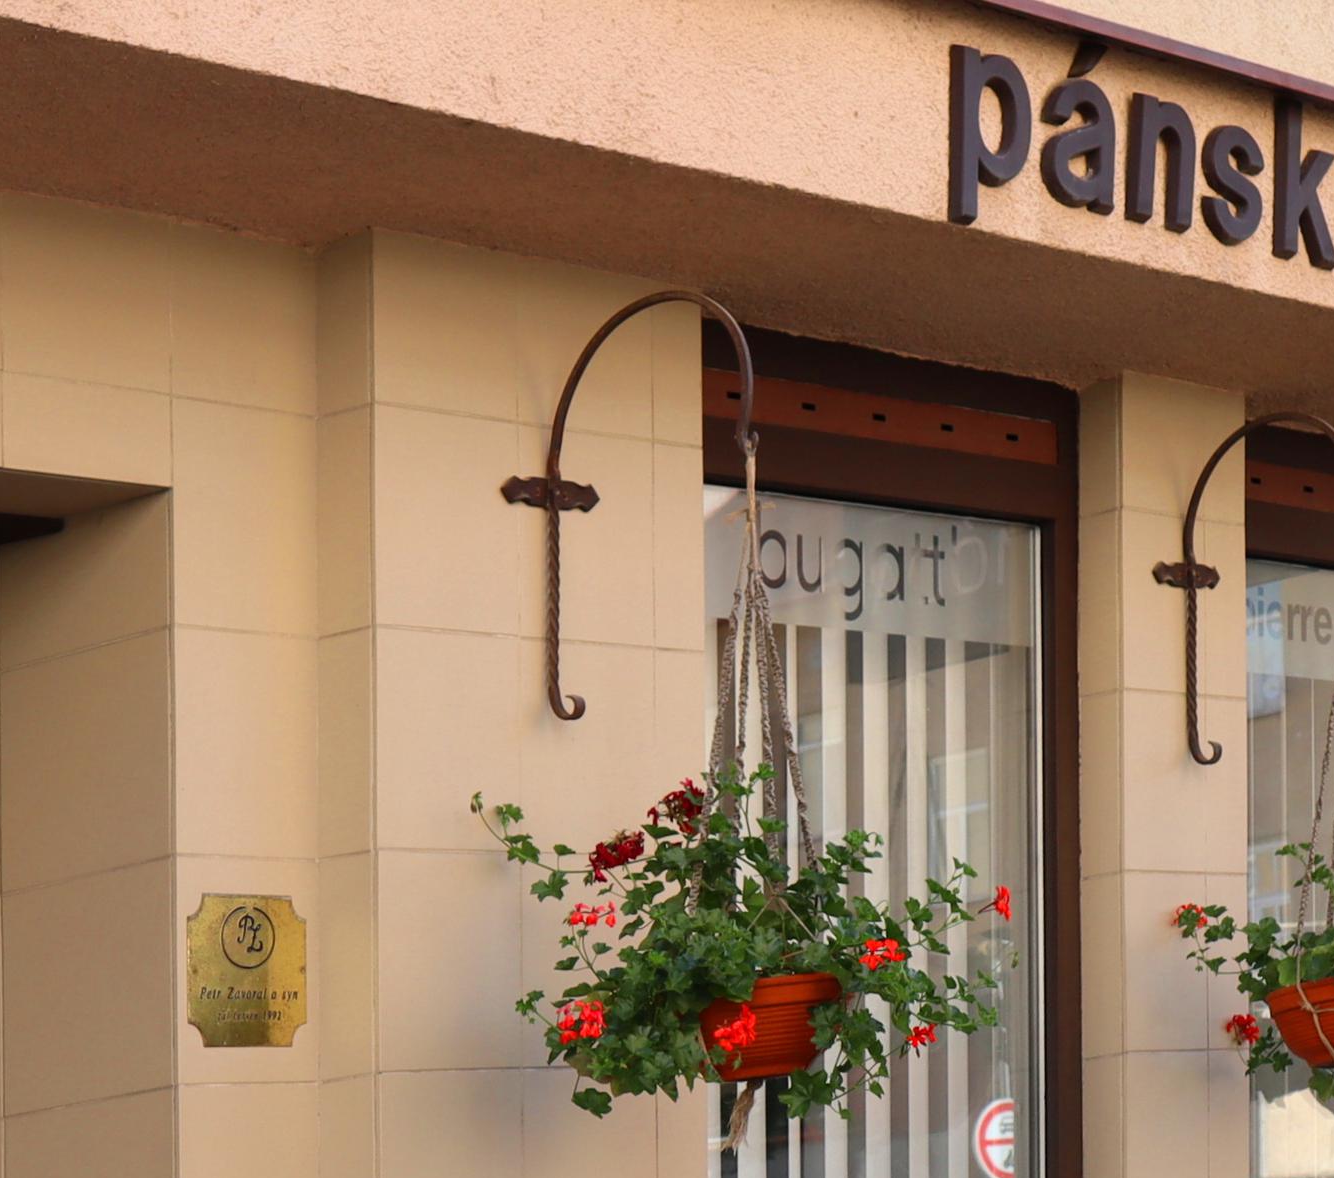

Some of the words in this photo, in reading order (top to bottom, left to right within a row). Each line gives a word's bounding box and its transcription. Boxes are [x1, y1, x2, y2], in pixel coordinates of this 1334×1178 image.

[199, 986, 222, 1000] Petr
[227, 986, 267, 1000] Zavoral
[281, 990, 299, 1003] syn
